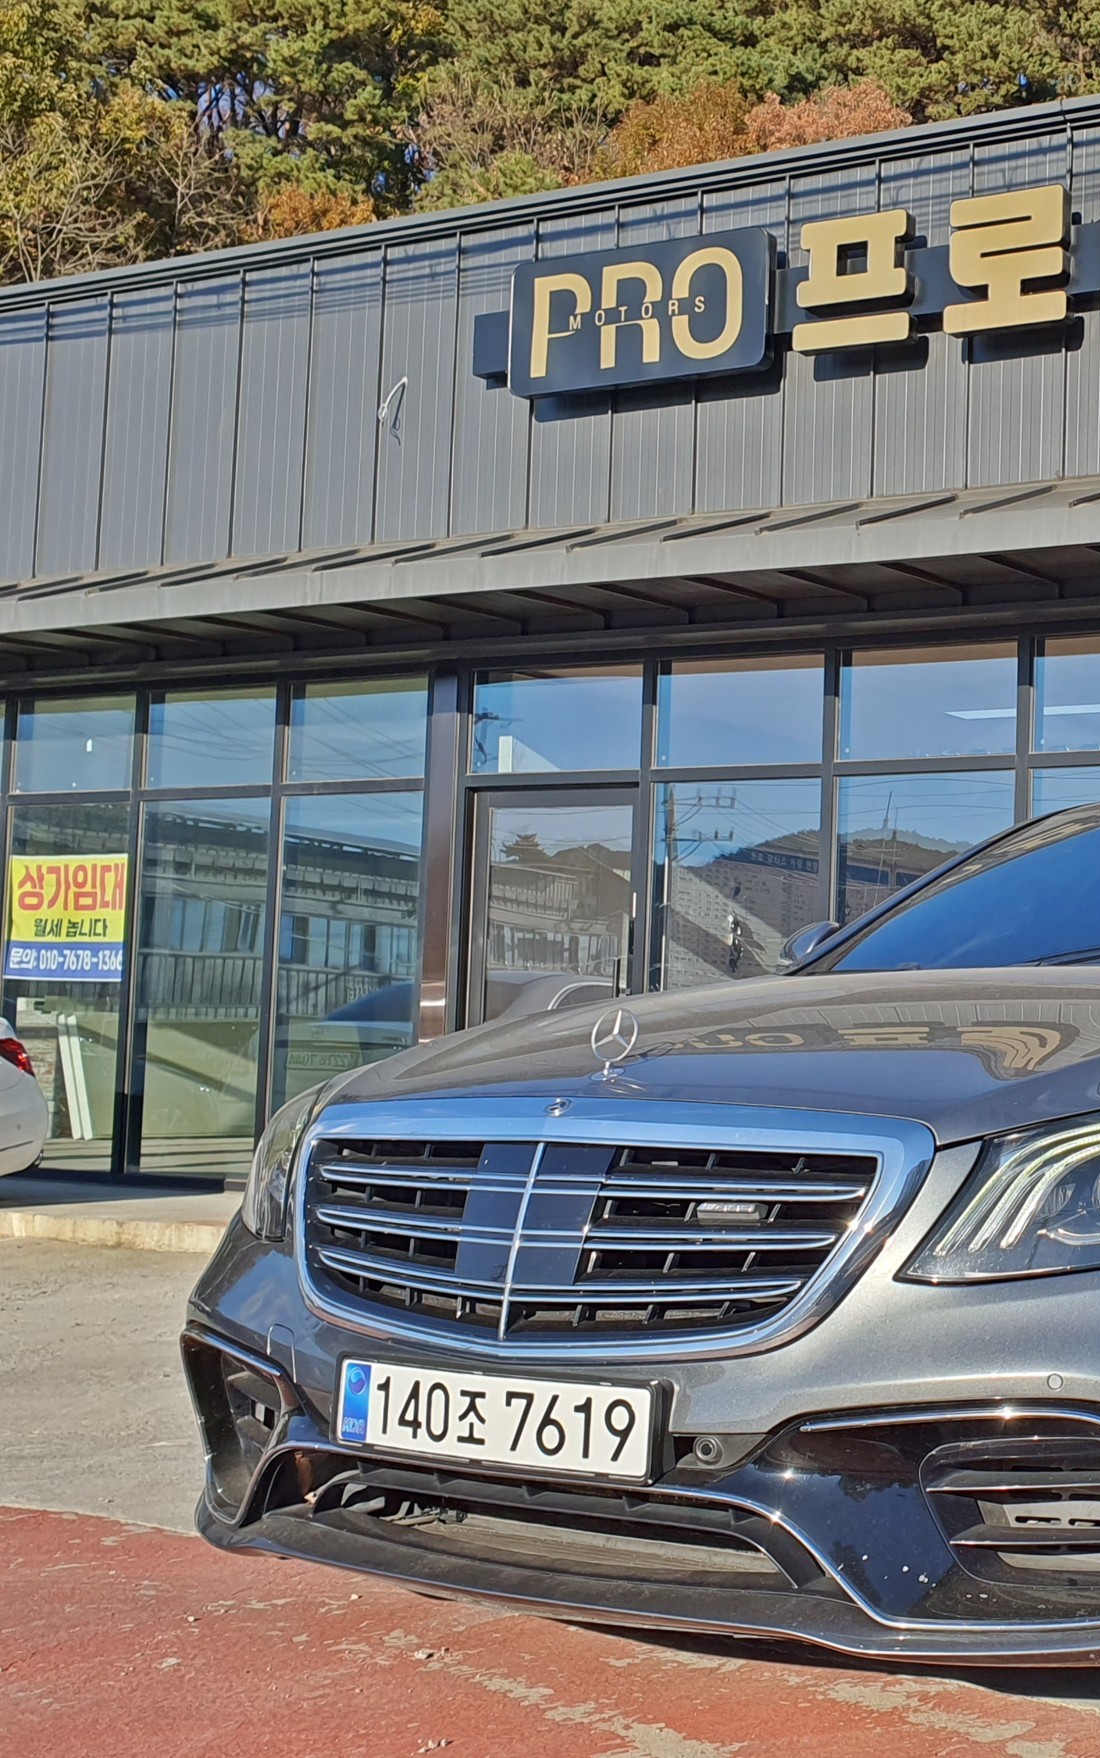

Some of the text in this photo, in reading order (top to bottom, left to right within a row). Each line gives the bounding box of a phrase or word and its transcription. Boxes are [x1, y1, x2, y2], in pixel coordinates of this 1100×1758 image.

[529, 246, 744, 379] PRO
[568, 295, 706, 331] MOTORS
[17, 862, 125, 911] 상가임대
[34, 918, 63, 938] 월세
[376, 1375, 637, 1462] 140조 7619
